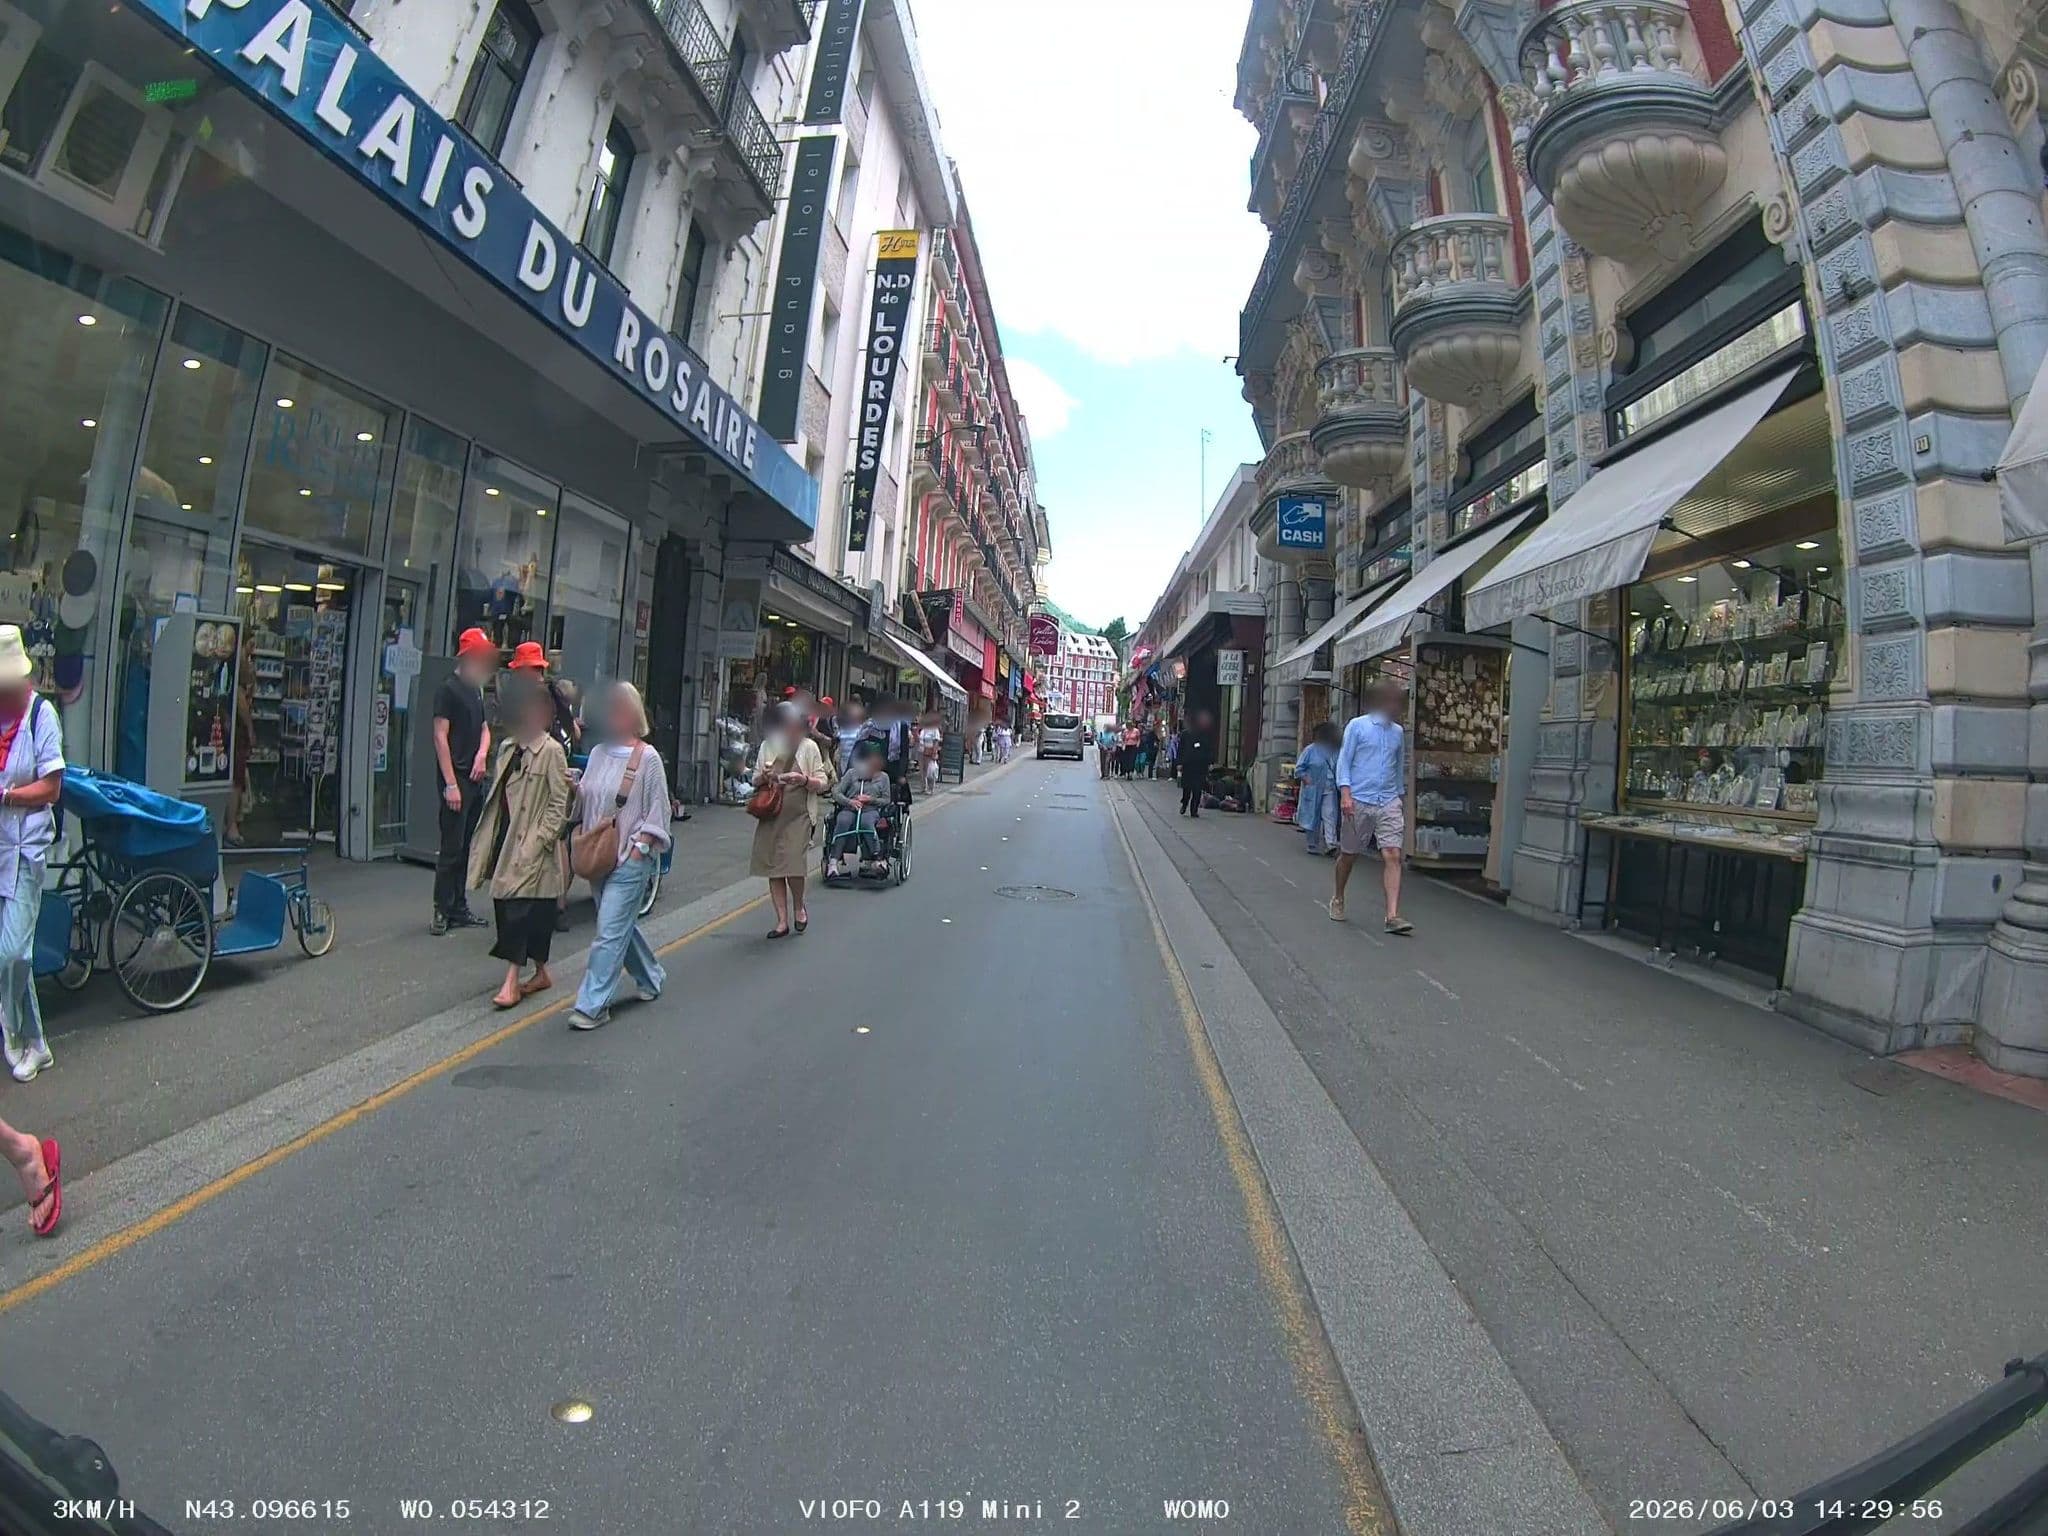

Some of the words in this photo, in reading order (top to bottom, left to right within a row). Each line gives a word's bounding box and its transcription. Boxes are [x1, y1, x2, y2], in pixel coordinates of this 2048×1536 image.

[185, 0, 495, 239] ALAIS
[517, 218, 598, 328] DU
[614, 307, 758, 470] ROSAIRE
[877, 274, 911, 289] N.D
[880, 292, 899, 305] de
[778, 277, 801, 379] grand
[859, 312, 898, 470] LOURDES
[1282, 529, 1323, 543] CASH
